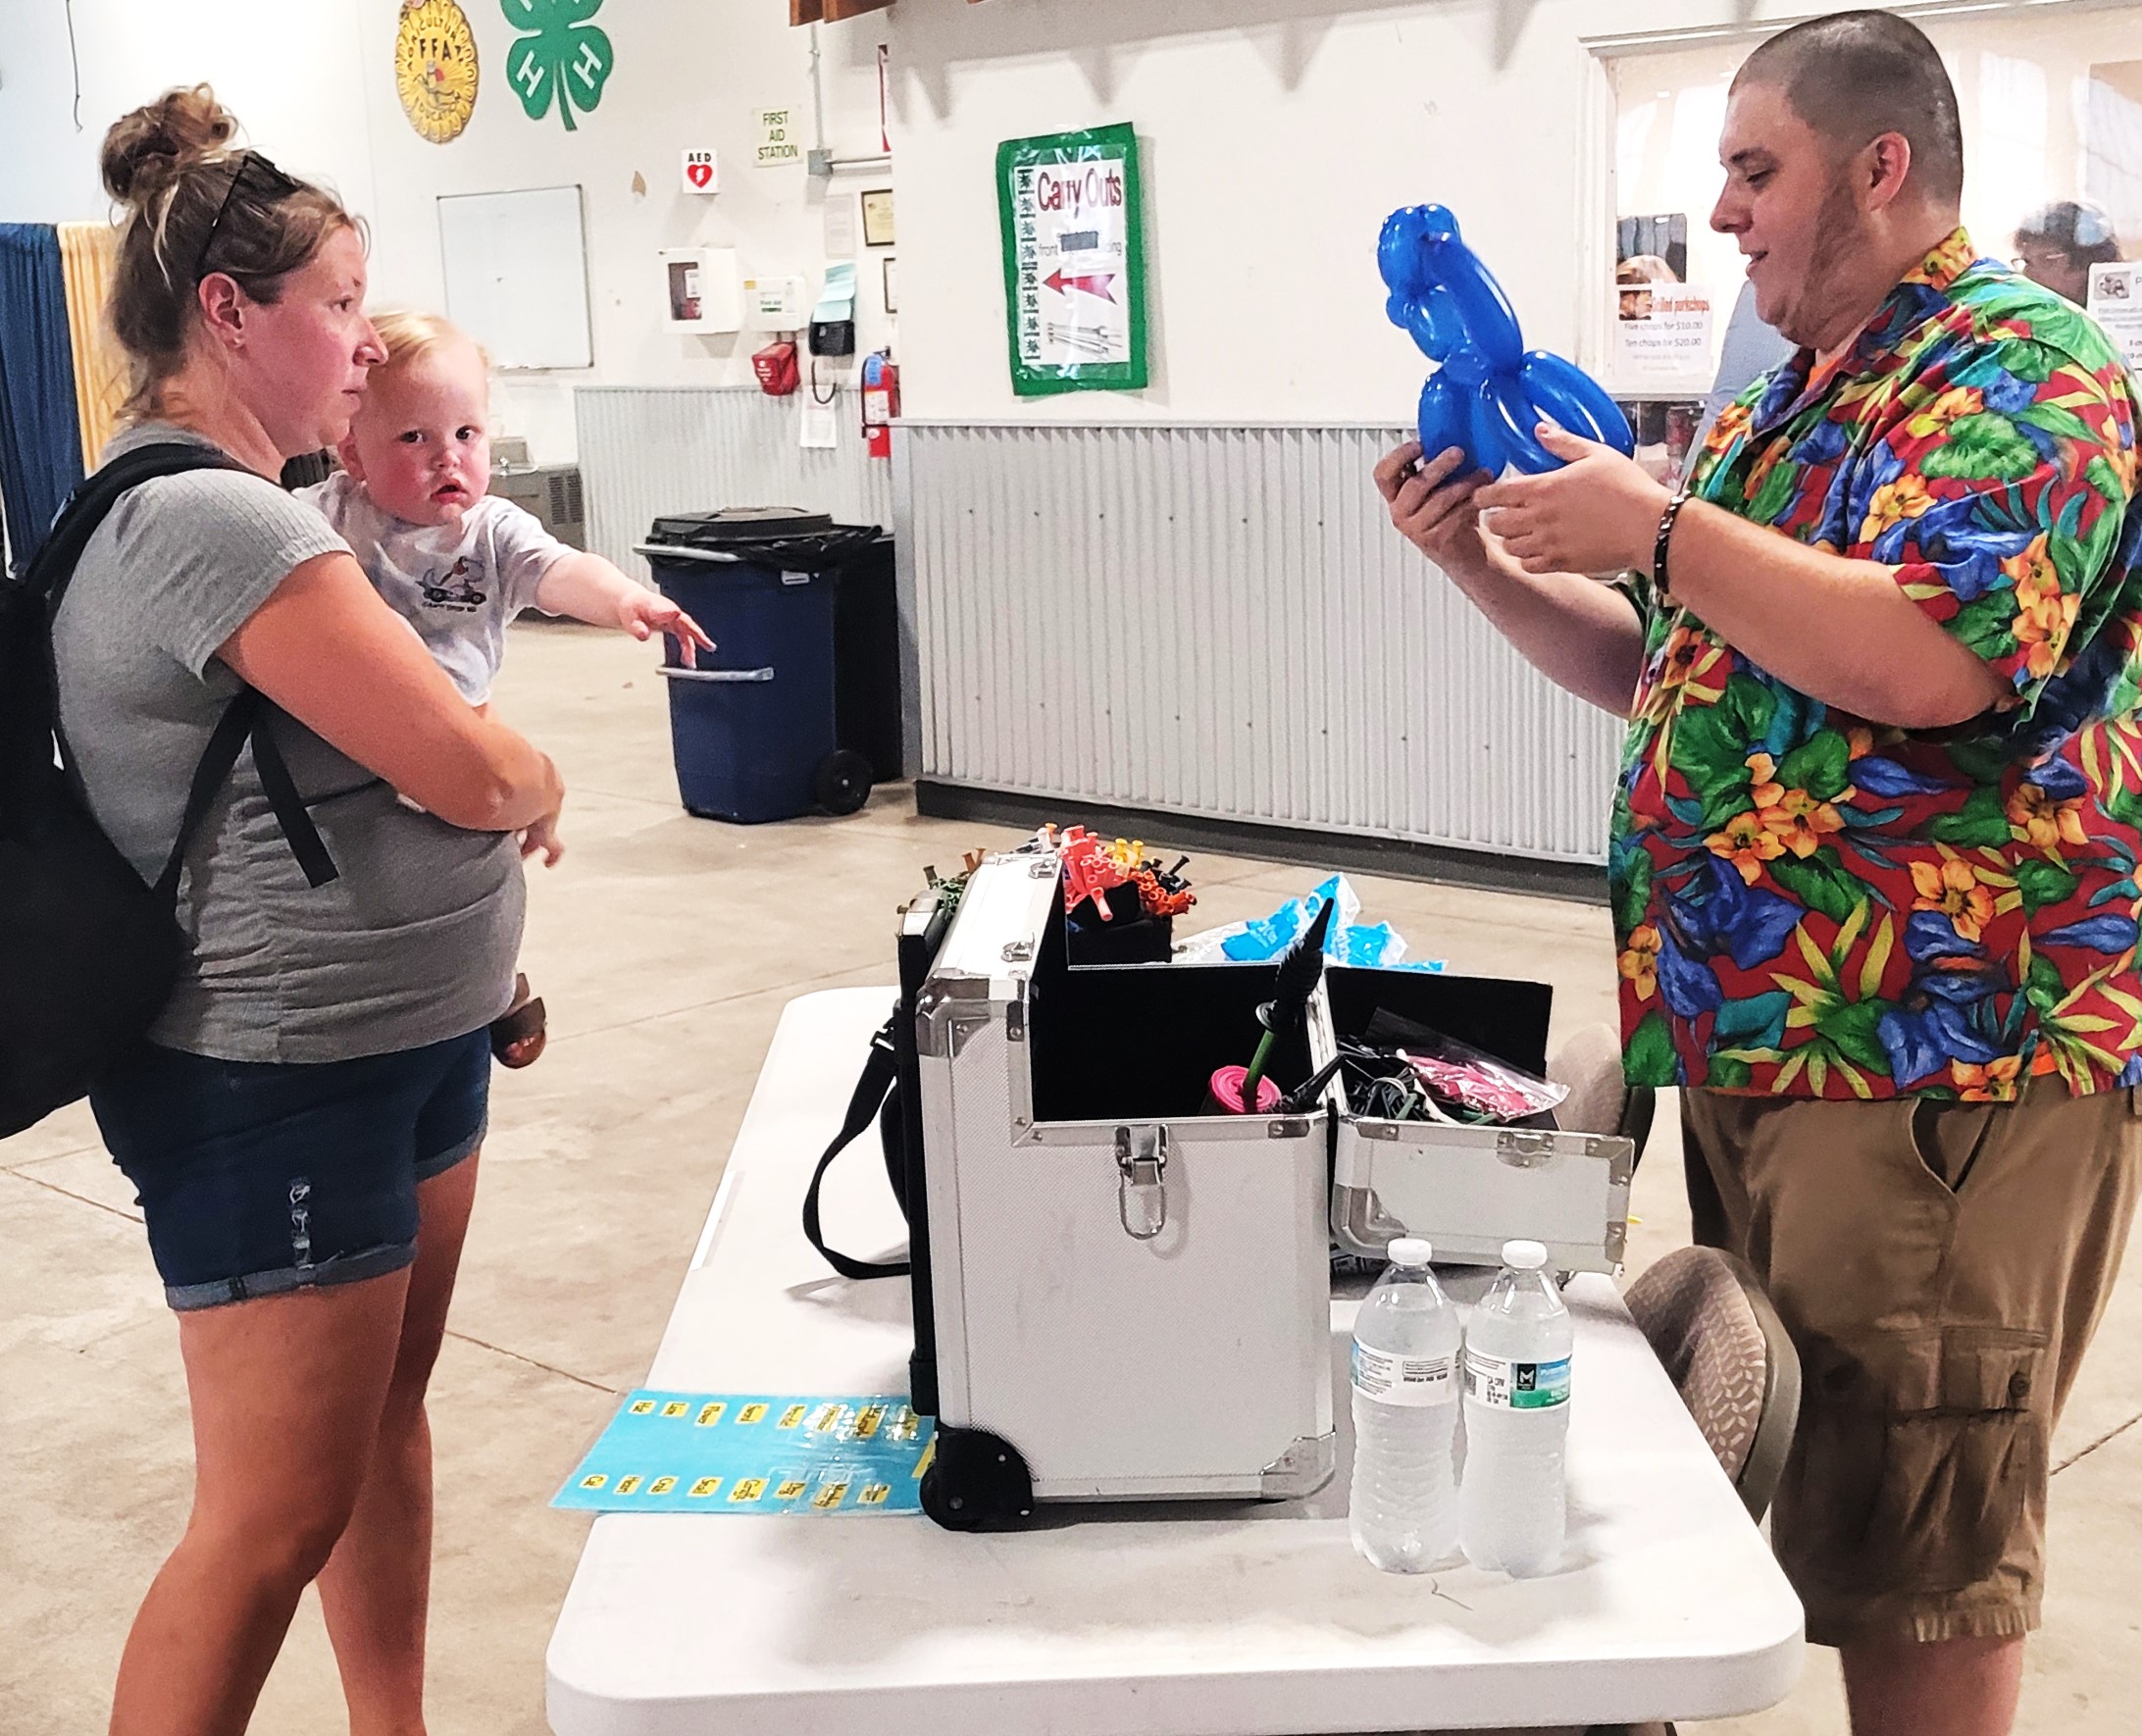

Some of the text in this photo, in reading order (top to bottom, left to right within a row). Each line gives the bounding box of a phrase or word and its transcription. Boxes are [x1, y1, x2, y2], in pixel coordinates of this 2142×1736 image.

[420, 37, 452, 62] FFA
[516, 49, 545, 99] H
[573, 41, 603, 90] H
[762, 111, 789, 126] FIRST
[769, 128, 786, 142] AID
[688, 152, 712, 163] AED
[757, 144, 798, 160] STATION
[1038, 168, 1122, 220] Carry Outs
